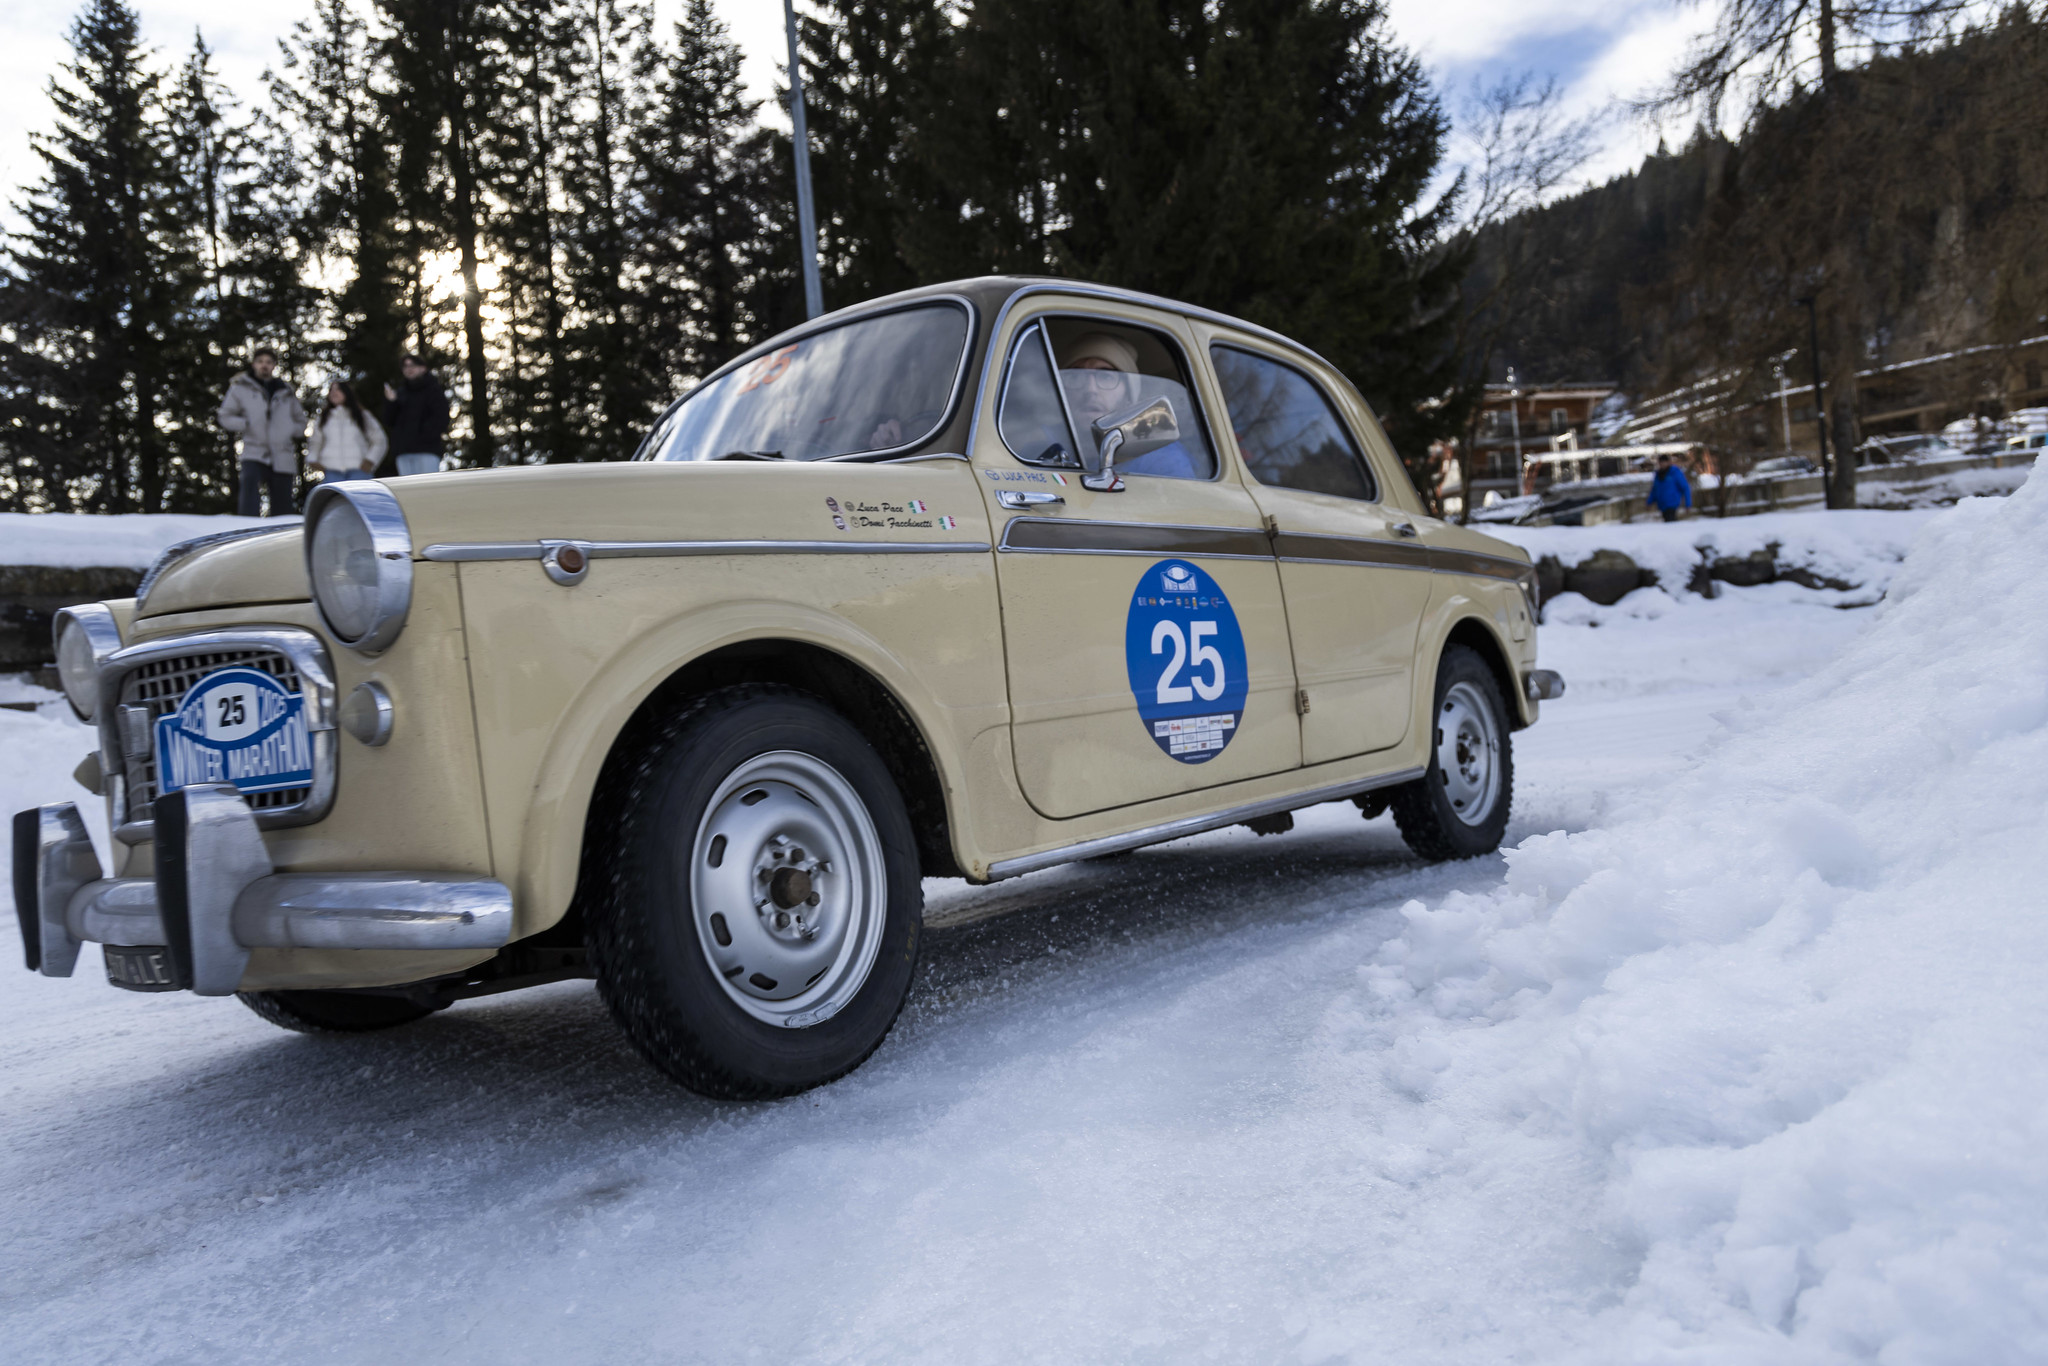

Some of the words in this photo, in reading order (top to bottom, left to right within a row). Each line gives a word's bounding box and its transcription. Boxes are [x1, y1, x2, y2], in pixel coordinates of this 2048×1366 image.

[737, 344, 798, 396] 25
[1001, 472, 1025, 481] LUCA
[857, 502, 879, 512] Luca
[881, 502, 904, 513] Pace
[1151, 620, 1225, 704] 25
[218, 694, 245, 727] 25
[165, 724, 225, 787] WINTER
[227, 704, 312, 780] MARATHON
